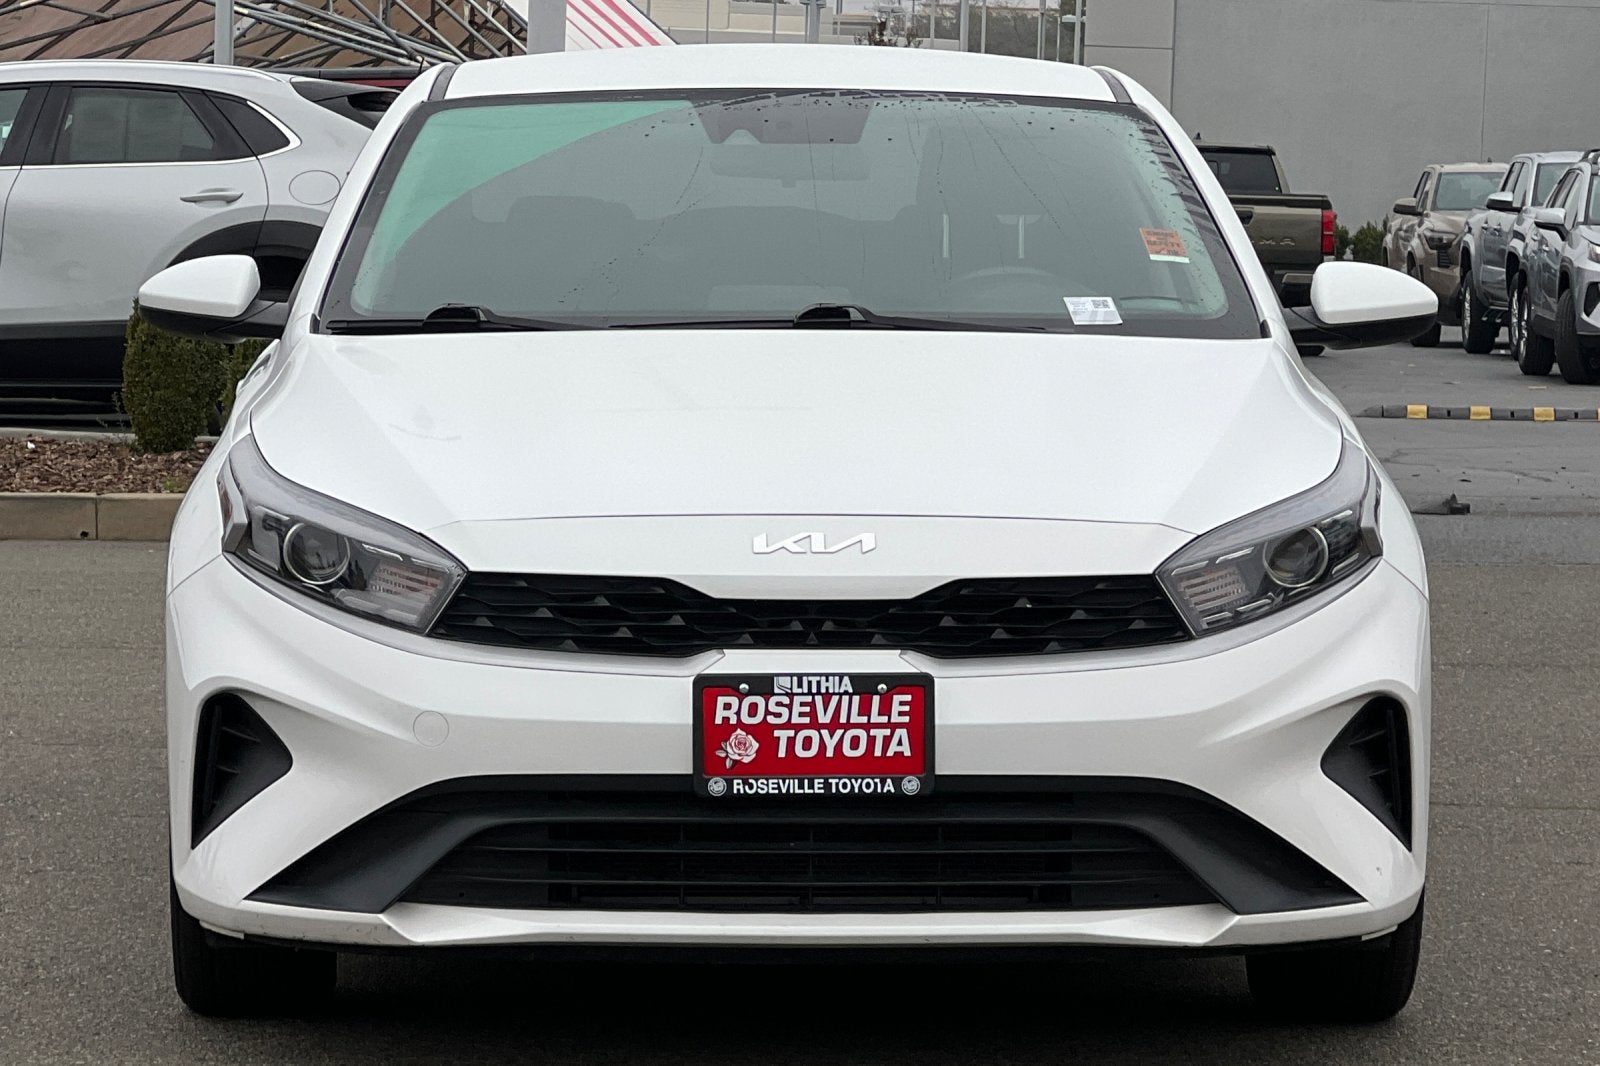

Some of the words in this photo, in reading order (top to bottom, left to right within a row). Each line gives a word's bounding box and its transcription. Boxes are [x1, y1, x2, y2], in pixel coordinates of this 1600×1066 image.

[752, 532, 876, 554] KIA
[792, 676, 853, 693] LITHIA
[715, 695, 912, 724] ROSEVILLE
[774, 728, 912, 757] TOYOTA
[733, 778, 825, 794] ROSEVILLE
[829, 778, 895, 793] TOYOTA
